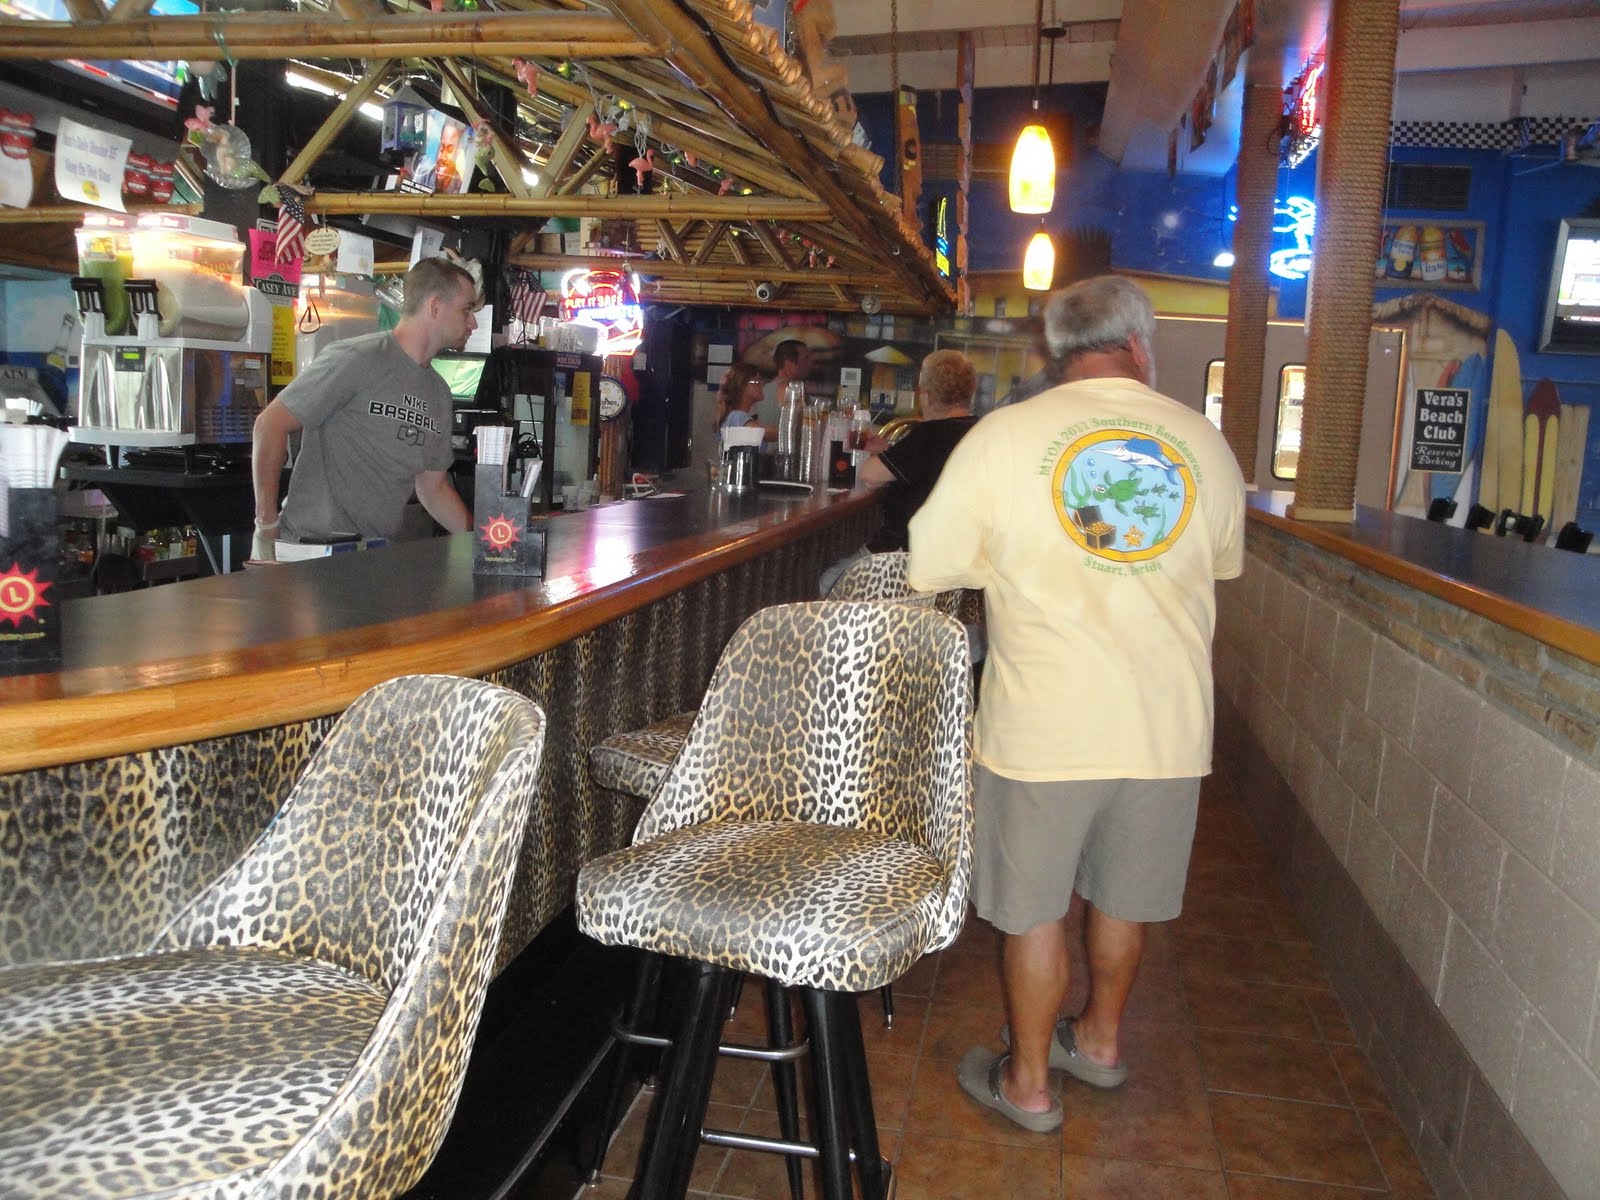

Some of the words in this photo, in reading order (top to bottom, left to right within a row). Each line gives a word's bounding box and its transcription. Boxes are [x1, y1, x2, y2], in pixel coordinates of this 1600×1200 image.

[256, 280, 280, 294] CASEY
[283, 285, 297, 297] AVE
[565, 297, 586, 309] PLAY
[588, 296, 596, 308] IT
[597, 290, 623, 308] SAFE
[402, 394, 428, 413] NIKE
[1423, 391, 1463, 408] Vera's
[368, 400, 441, 435] BASEBALL
[1089, 416, 1153, 432] Southern
[1419, 407, 1464, 425] Beach
[1423, 425, 1457, 440] Club
[1415, 445, 1462, 458] Reserved
[1418, 455, 1456, 468] Parking
